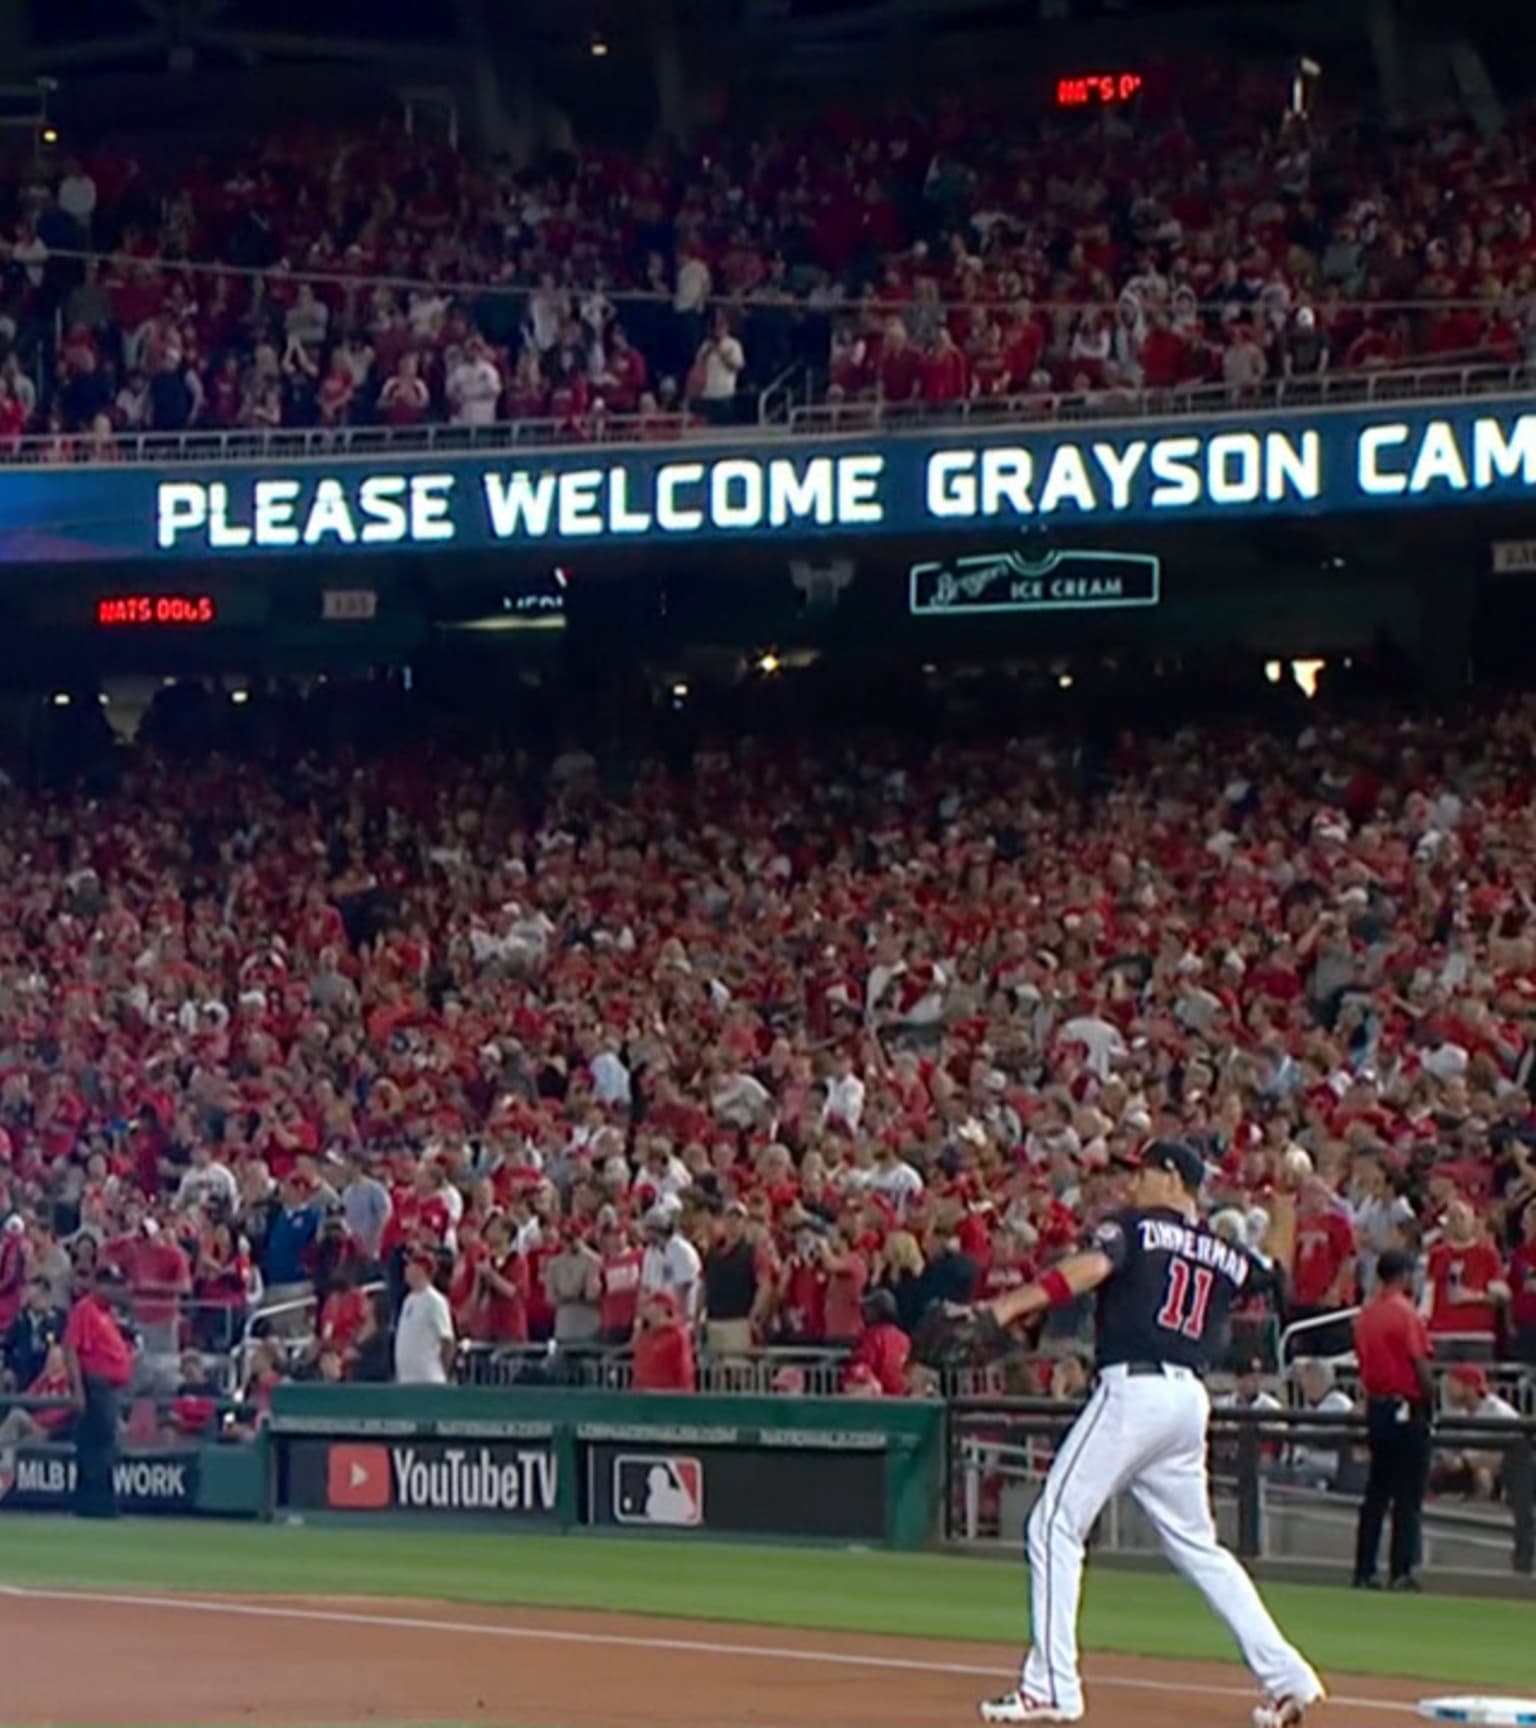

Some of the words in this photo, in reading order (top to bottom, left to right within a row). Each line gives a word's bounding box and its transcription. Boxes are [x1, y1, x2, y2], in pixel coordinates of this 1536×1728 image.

[157, 475, 455, 548] PLEASE
[484, 456, 884, 538] WELCOME
[927, 429, 1320, 516] GRAYSON
[1358, 413, 1536, 495] CAM
[1011, 580, 1043, 598] ICE
[1051, 577, 1123, 598] CREAM
[1157, 1255, 1213, 1341] 11
[17, 1461, 65, 1491] MLB
